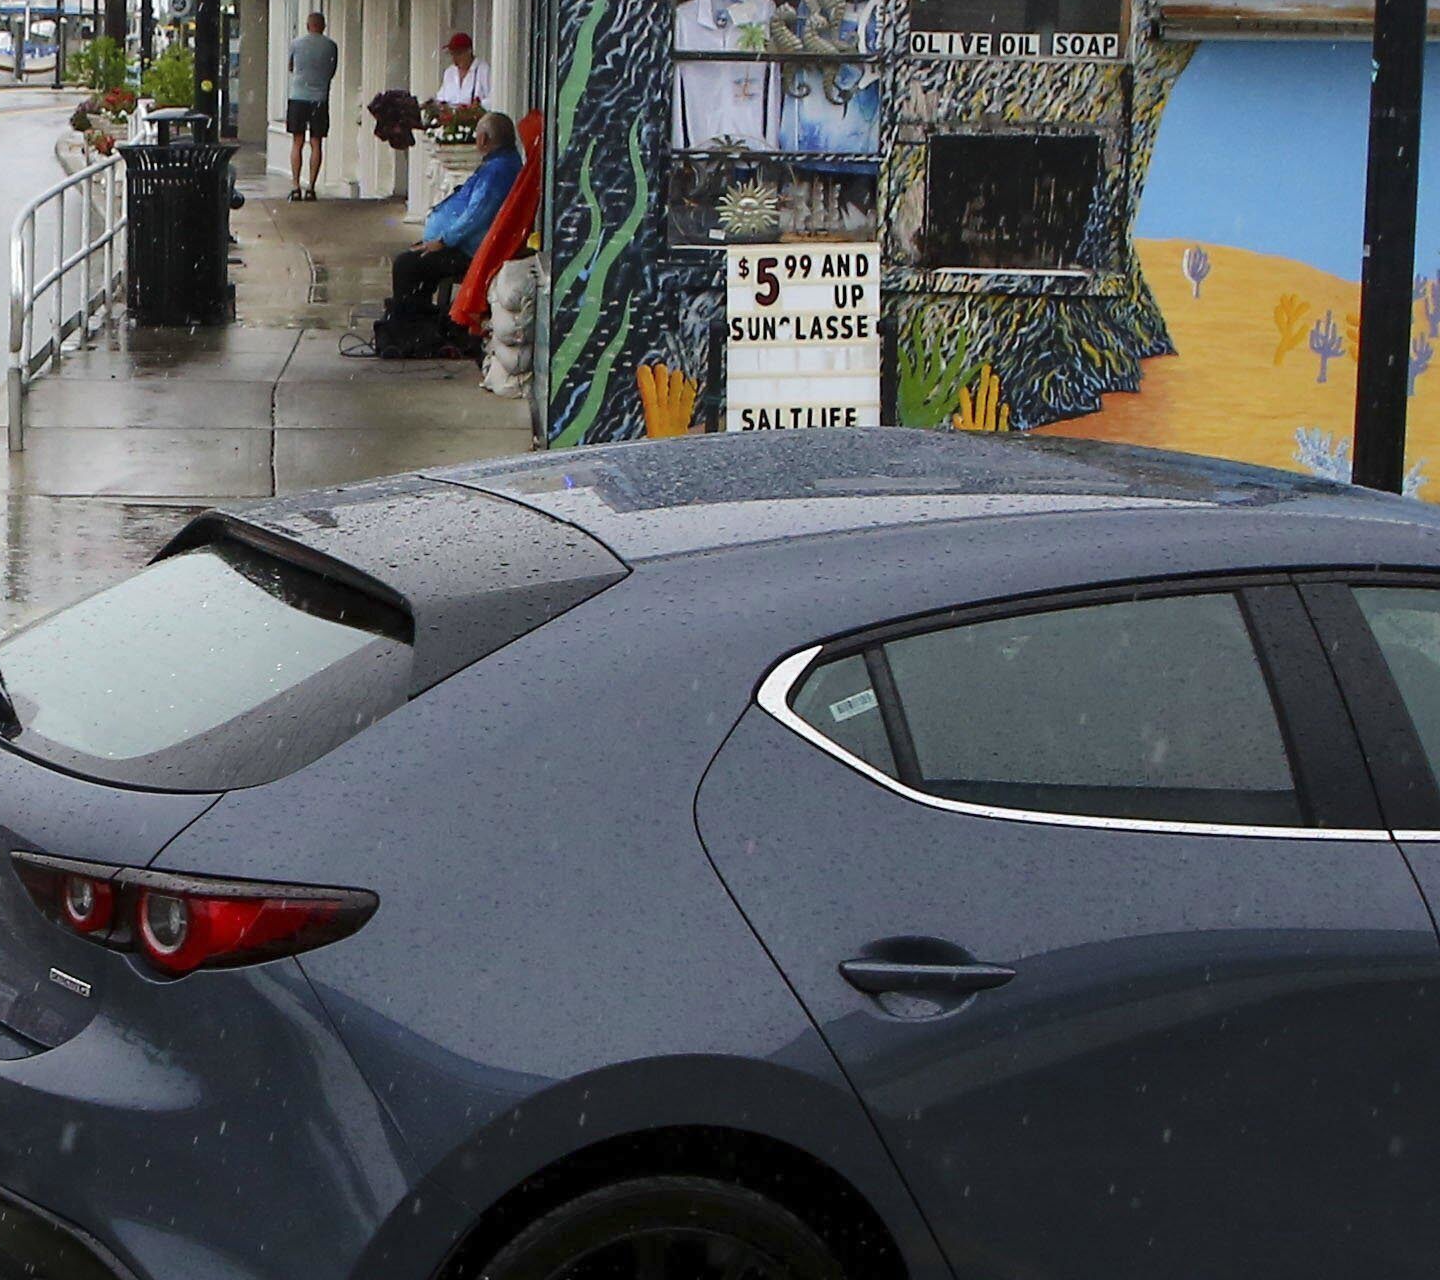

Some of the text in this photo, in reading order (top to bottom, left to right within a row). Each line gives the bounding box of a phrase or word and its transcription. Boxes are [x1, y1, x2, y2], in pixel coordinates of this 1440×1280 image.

[911, 34, 1116, 57] OLIVE OIL SOAP
[821, 254, 869, 278] AND
[834, 284, 864, 308] UP
[731, 315, 868, 341] SUNLASSE
